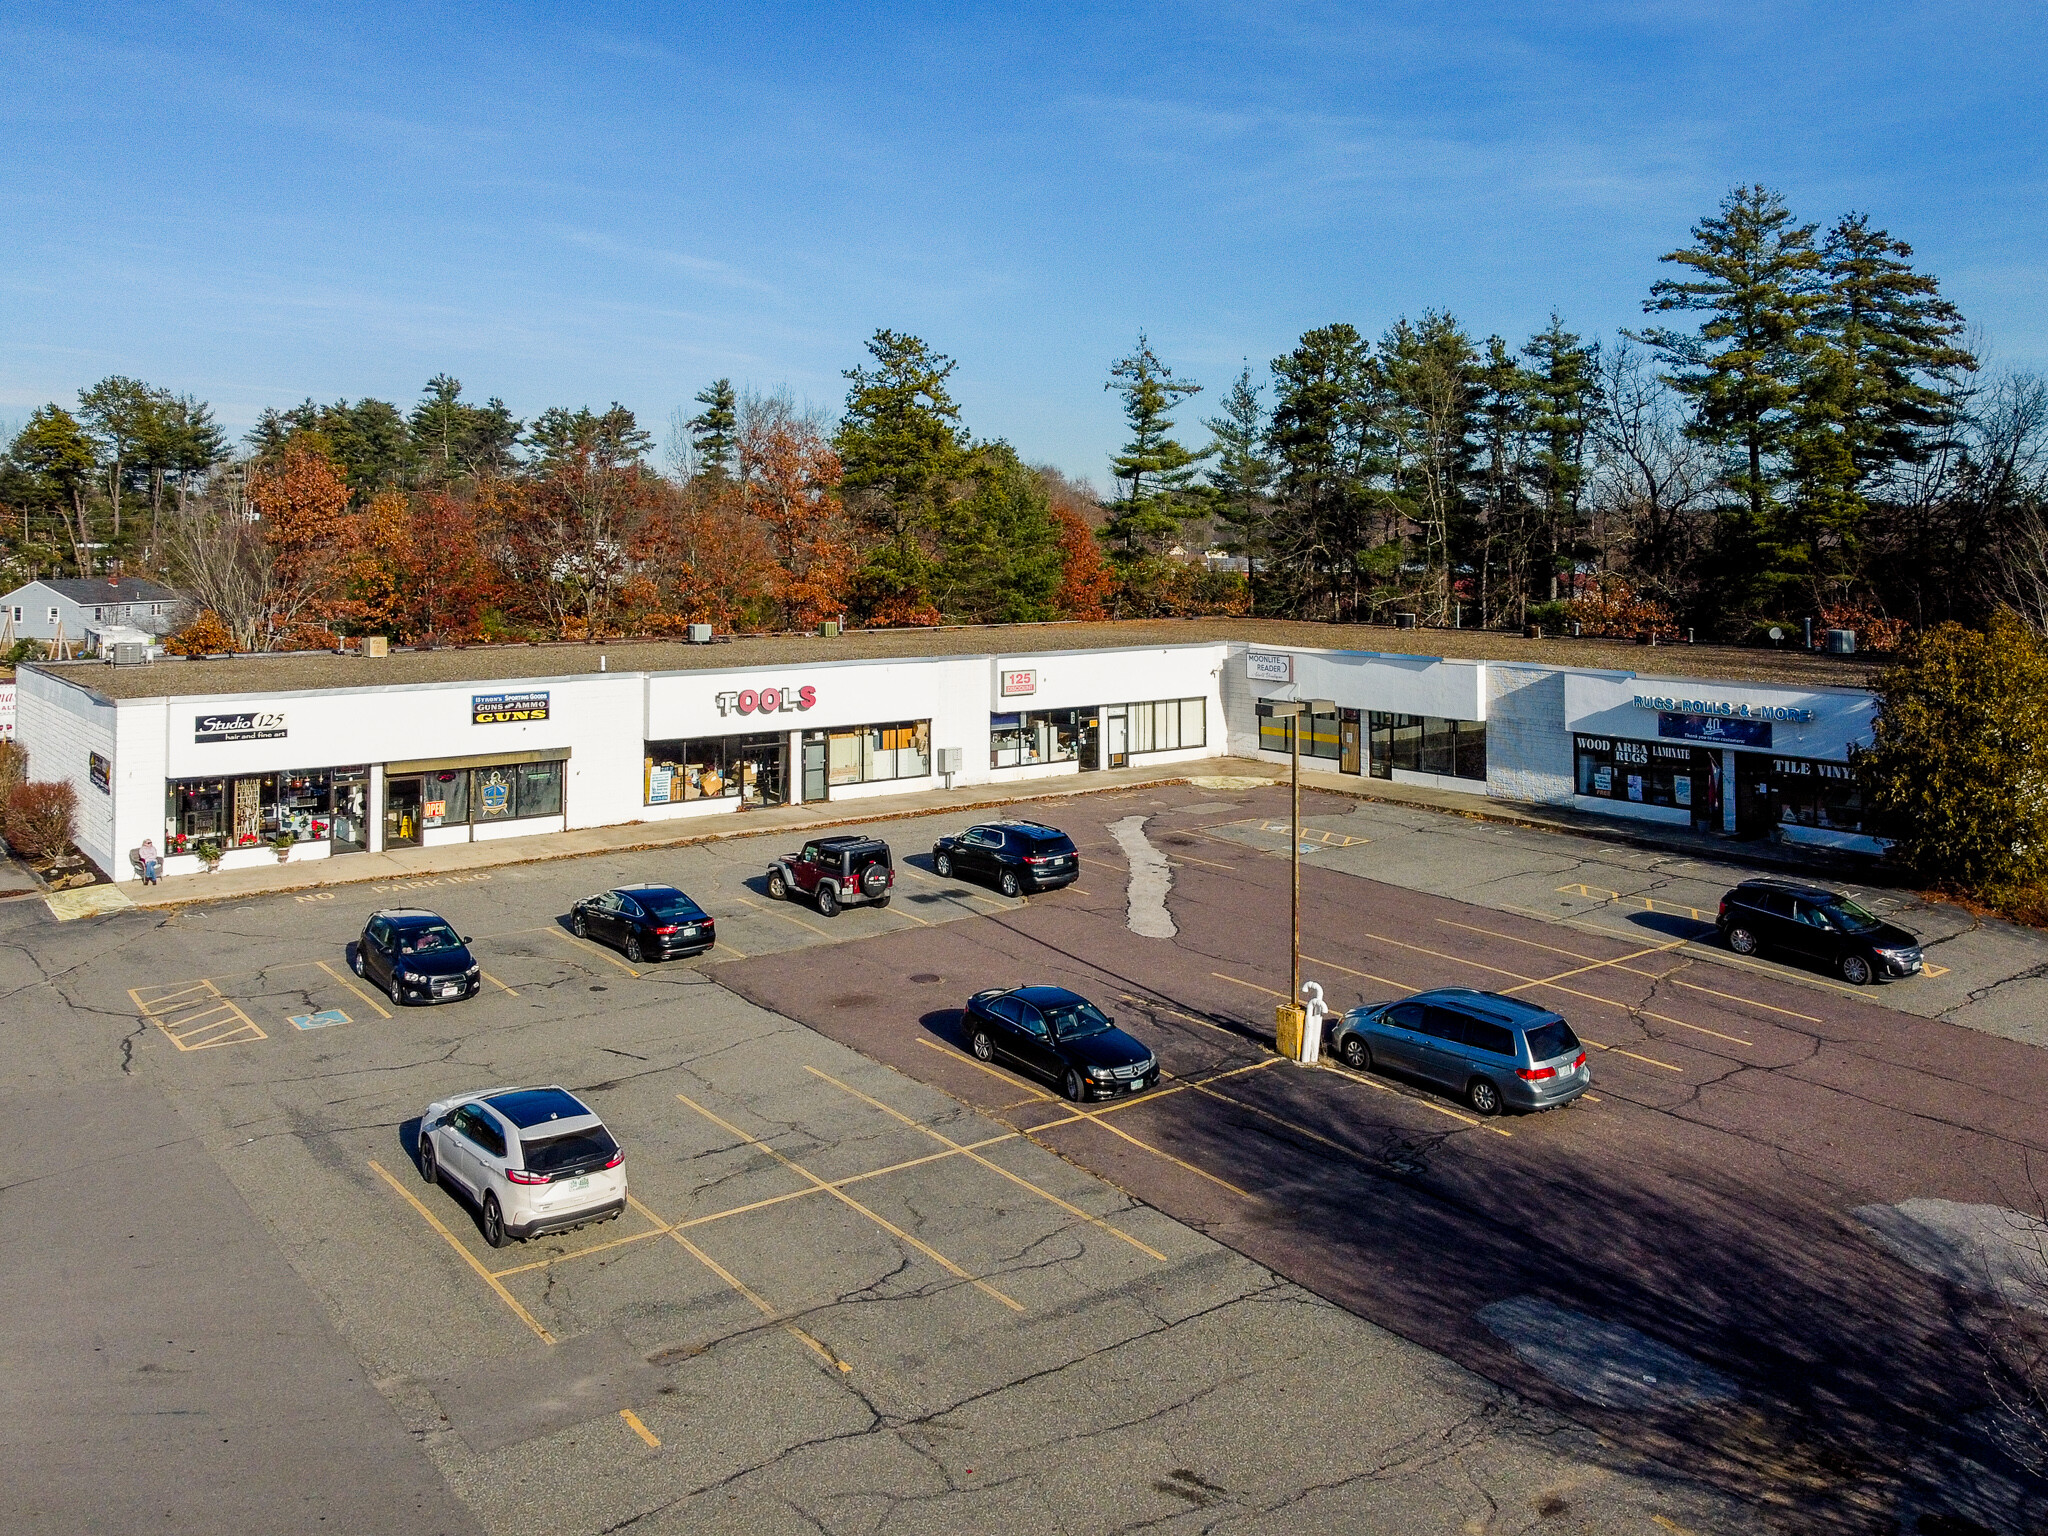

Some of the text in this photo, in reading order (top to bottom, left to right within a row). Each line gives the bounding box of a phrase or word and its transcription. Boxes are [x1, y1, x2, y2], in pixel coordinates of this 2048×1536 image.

[1248, 655, 1281, 664] MOONLITE
[1257, 664, 1281, 673] READER
[1009, 673, 1031, 685] 125
[1007, 684, 1033, 692] DISCOUNT
[477, 703, 504, 711] GUNS
[515, 701, 546, 709] AMMO
[717, 685, 817, 715] TOOLS
[1633, 695, 1813, 723] RUGS ROLLS & MORE
[199, 713, 285, 732] Studio 125
[476, 709, 546, 723] GUNS
[225, 733, 240, 741] hair
[241, 732, 255, 740] and
[257, 731, 272, 739] fine
[1577, 738, 1610, 751] WOOD
[1615, 742, 1648, 755] AREA
[1616, 751, 1648, 764] RUGS
[1652, 746, 1691, 760] LAMINATE
[1773, 759, 1811, 775] TILE
[425, 801, 446, 817] OPEN
[293, 873, 492, 903] NO PARKING
